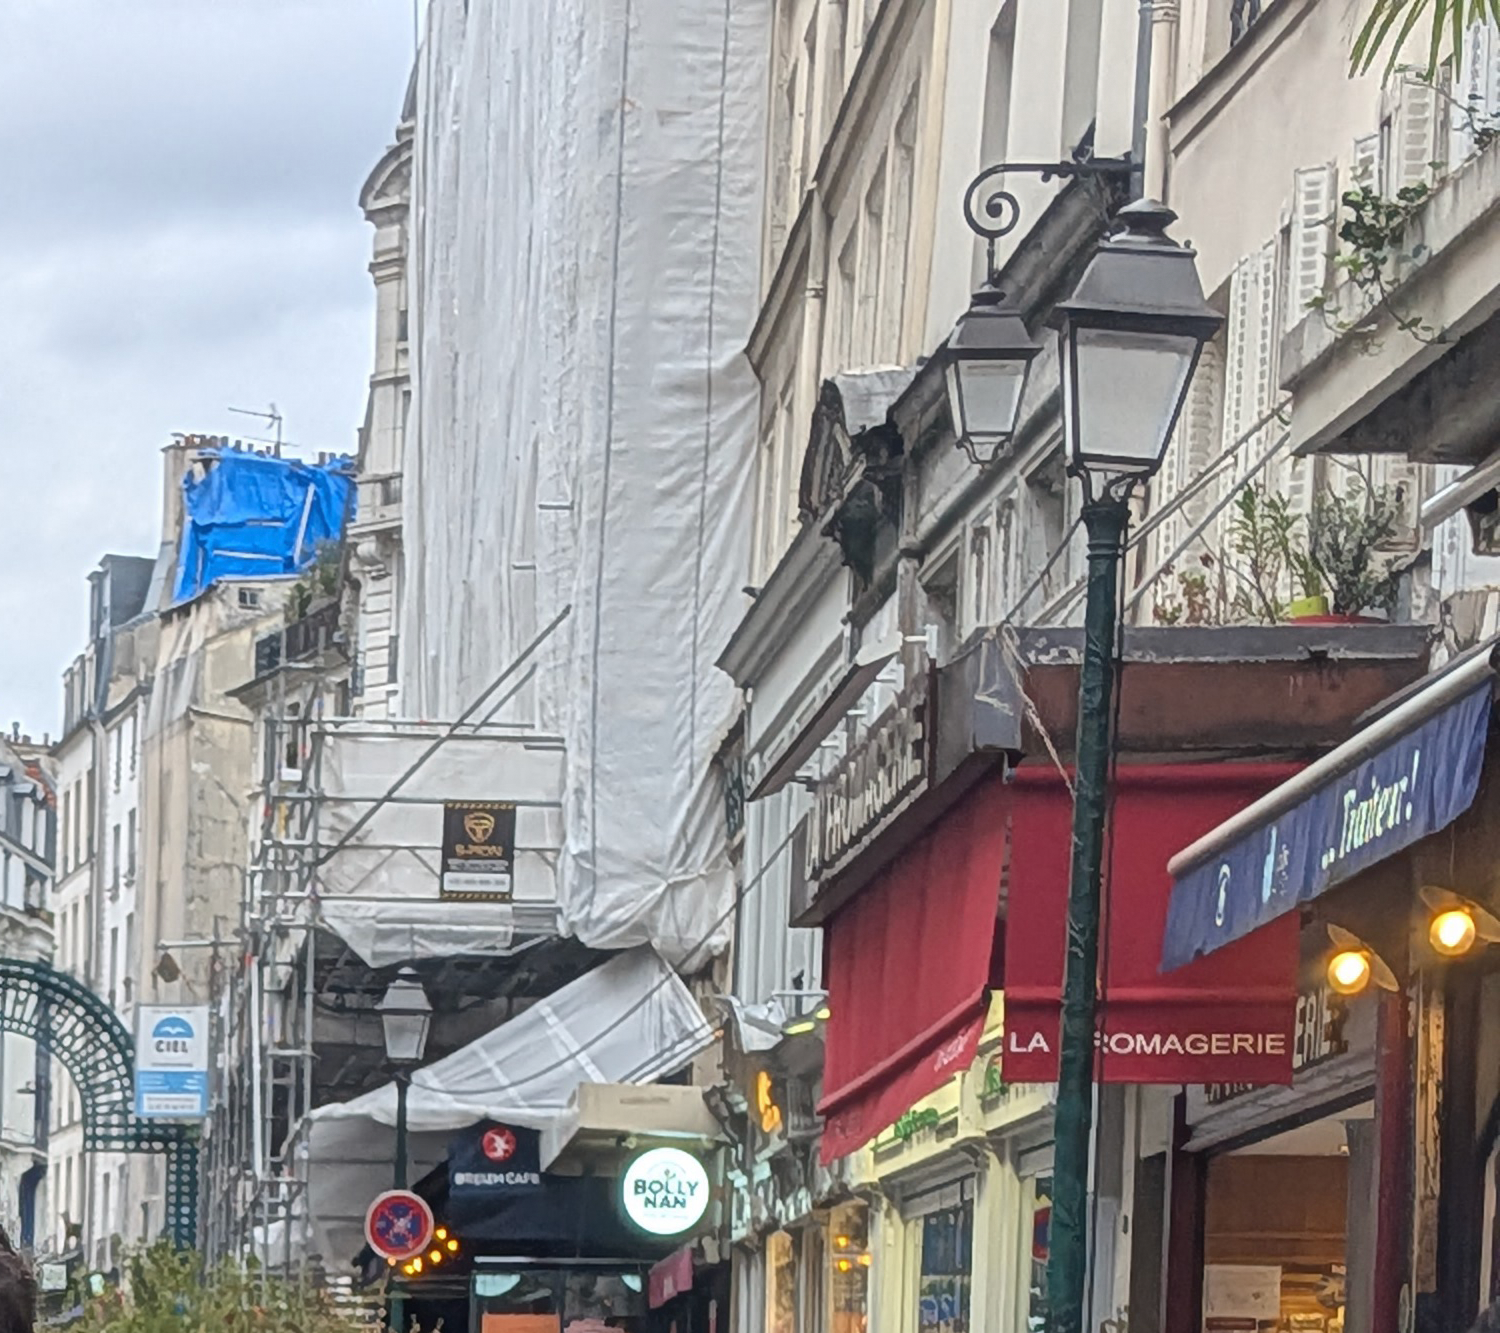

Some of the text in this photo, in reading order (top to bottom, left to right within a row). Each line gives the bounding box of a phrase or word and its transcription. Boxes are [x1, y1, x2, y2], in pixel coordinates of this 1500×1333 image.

[155, 1039, 189, 1054] CIEL
[1010, 1031, 1286, 1055] LA ROMAGERIE
[633, 1178, 699, 1197] BOLLY
[644, 1194, 687, 1209] NAN
